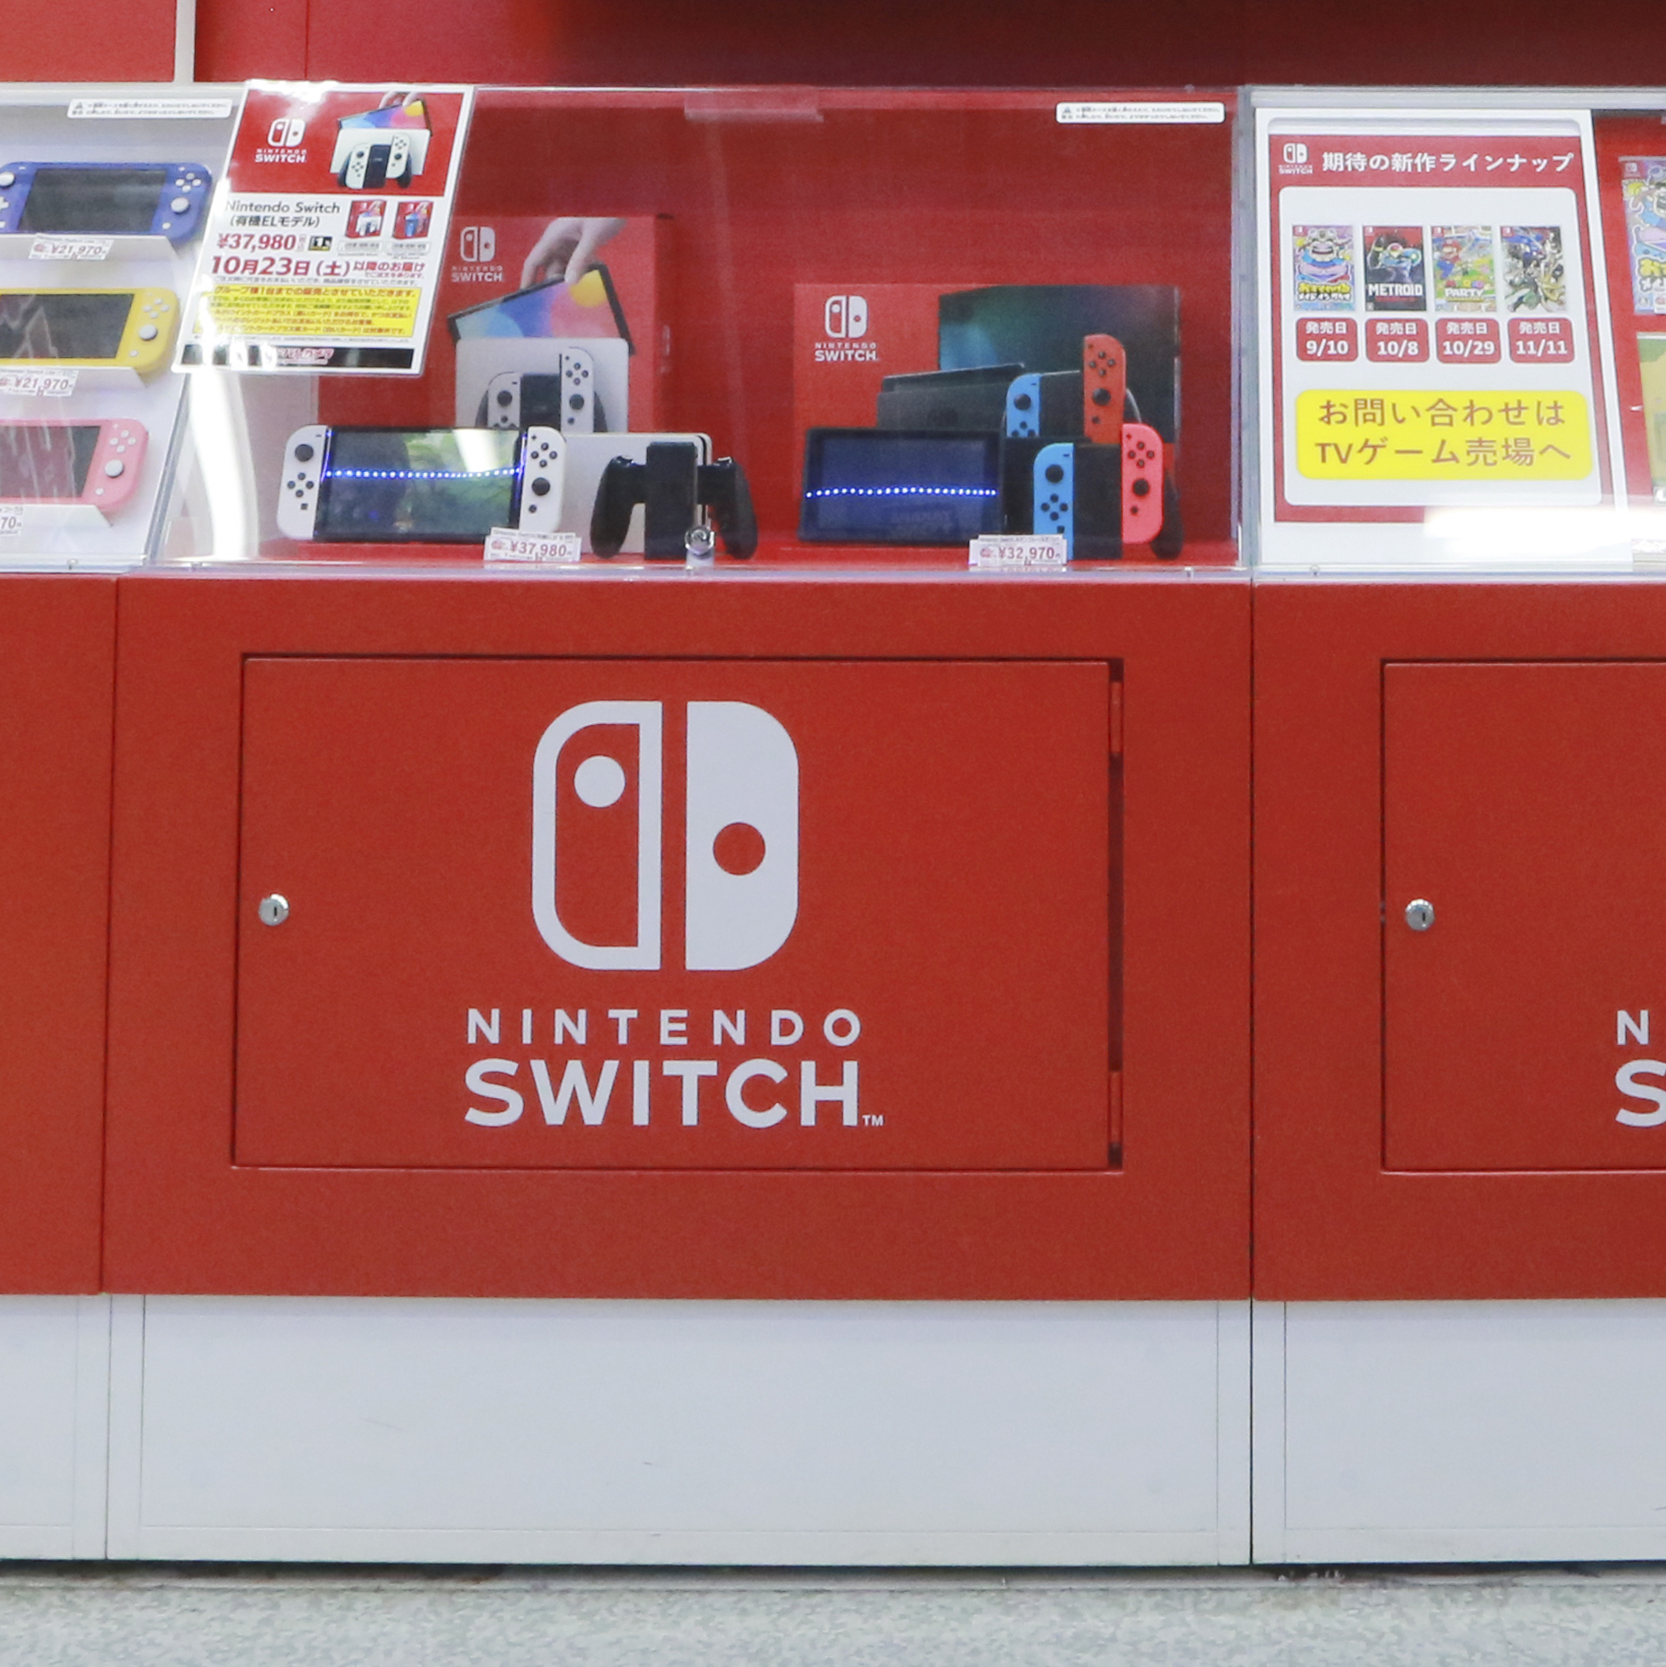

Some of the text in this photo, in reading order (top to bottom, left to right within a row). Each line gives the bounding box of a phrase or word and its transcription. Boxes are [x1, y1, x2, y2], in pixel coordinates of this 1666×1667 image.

[1321, 151, 1575, 173] 期待の新作ラインナップ
[450, 271, 504, 283] SWITCH
[1369, 284, 1424, 297] METROID
[814, 349, 879, 362] SWITCH
[1305, 339, 1350, 356] 9/10
[1377, 339, 1419, 356] 10/8
[1442, 339, 1496, 356] 10/29
[1515, 338, 1569, 356] 11/11
[1318, 397, 1566, 428] お問い合わせは
[1314, 436, 1572, 468] TVゲーム売場へ
[466, 1007, 862, 1048] NINTENDO
